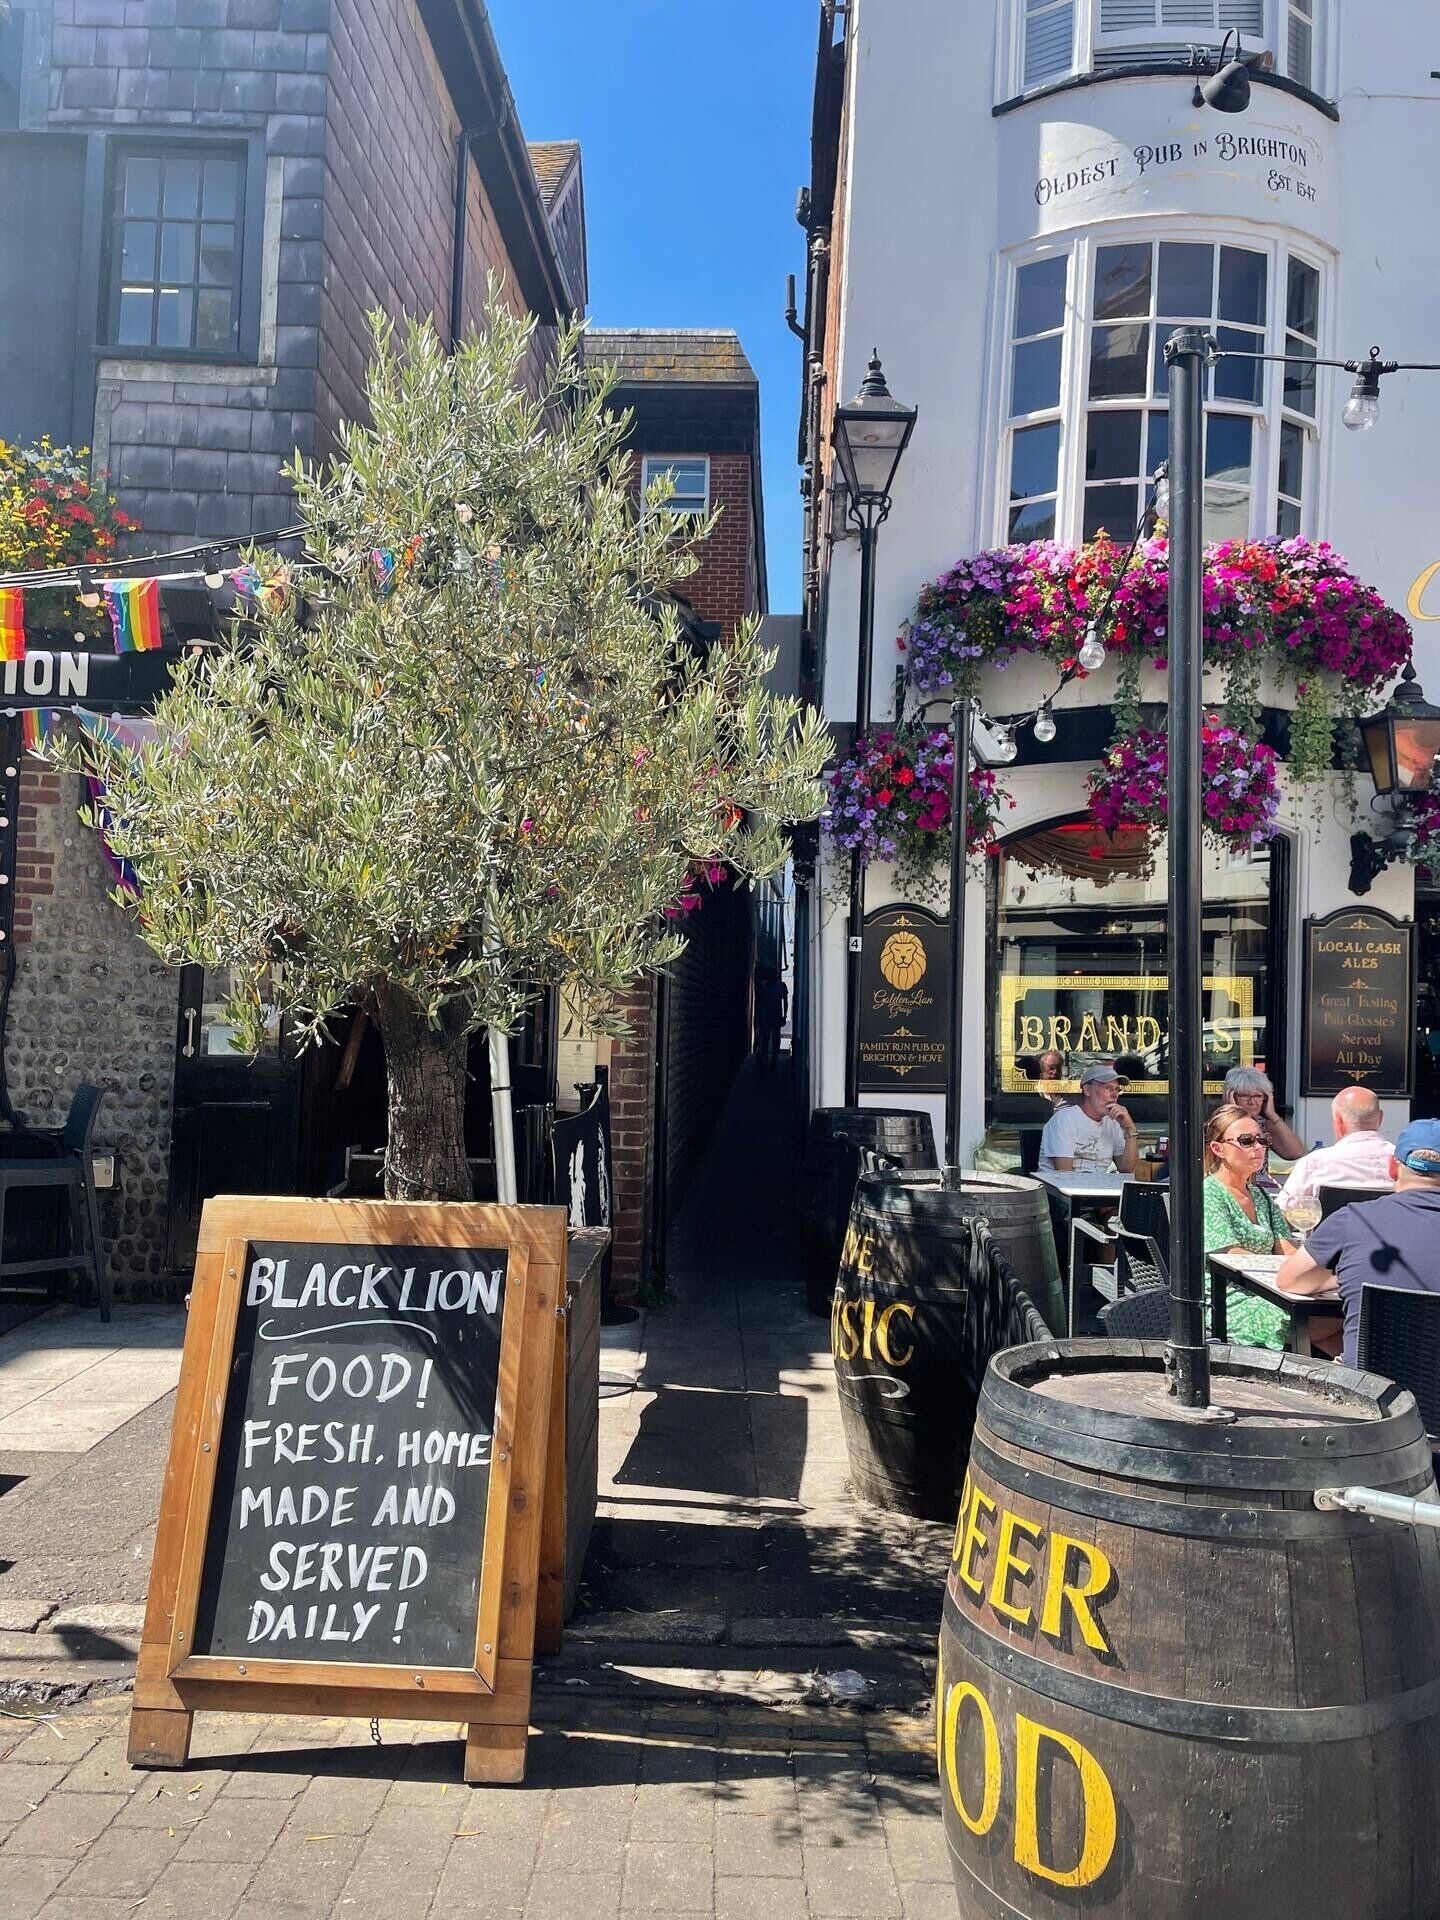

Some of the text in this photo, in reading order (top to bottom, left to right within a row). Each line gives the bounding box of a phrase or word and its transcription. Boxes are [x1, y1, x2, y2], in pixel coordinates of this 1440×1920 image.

[1034, 132, 1307, 206] OLDEST PUB IN BRIGHTON
[1296, 181, 1317, 203] 1547
[4, 650, 89, 697] ION
[851, 939, 859, 949] 4
[1317, 941, 1402, 955] LOCAL CASK
[1341, 957, 1379, 969] ALES
[872, 989, 933, 1010] Golden Lion
[1321, 993, 1398, 1014] Great Tasting
[1323, 1011, 1396, 1026] Pub Classics
[1020, 1014, 1234, 1053] BRANDS
[1341, 1032, 1381, 1046] Served
[860, 1042, 891, 1051] FAMILY
[892, 1043, 911, 1051] RUN
[912, 1043, 930, 1051] PUB
[862, 1053, 944, 1063] BRIGHTON & HOVE
[1335, 1050, 1383, 1068] All Day
[245, 1257, 503, 1315] BLACK LION
[267, 1352, 434, 1408] FOOD!
[397, 1430, 492, 1468] HOME
[239, 1484, 457, 1530] MADE AND
[259, 1541, 429, 1593] SERVED
